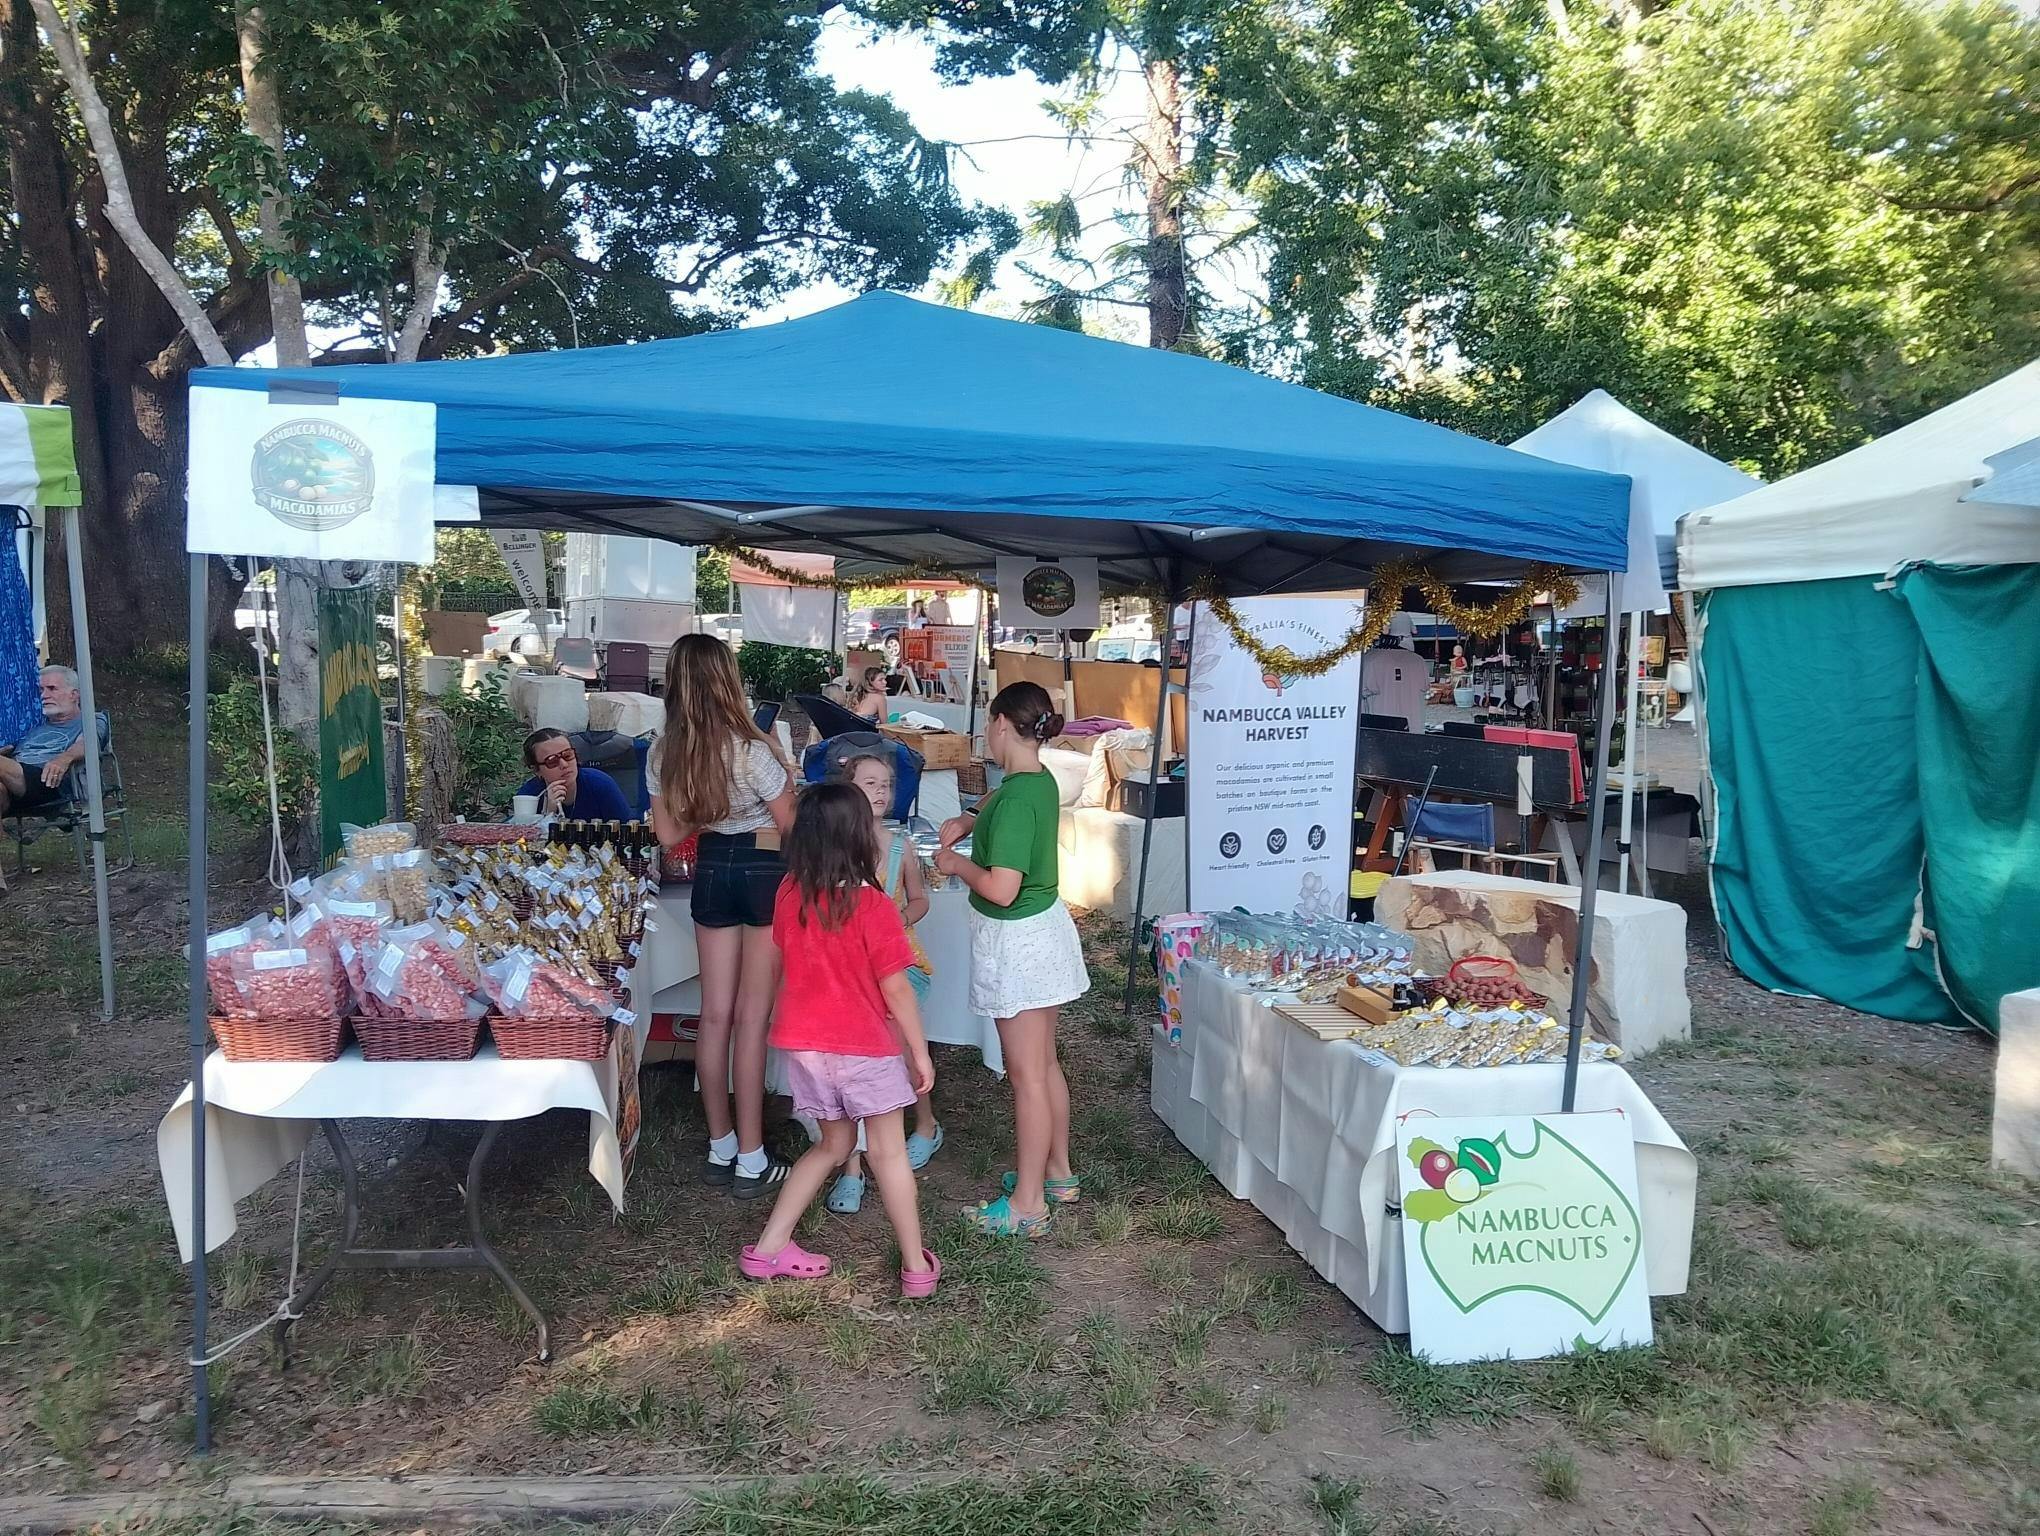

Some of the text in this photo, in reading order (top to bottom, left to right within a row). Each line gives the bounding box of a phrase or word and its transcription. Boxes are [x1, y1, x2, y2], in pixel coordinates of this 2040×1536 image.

[260, 423, 366, 458] NAMBUCCA MACNUTS
[270, 497, 356, 516] MACADAMIAS
[1203, 705, 1347, 723] NAMBUCCA VALLEY
[1246, 726, 1309, 742] HARVEST
[1216, 759, 1335, 771] Our delicious organic and premium
[1216, 776, 1260, 785] macadamias
[1275, 773, 1306, 783] cultivated
[1315, 771, 1334, 780] small
[1216, 791, 1243, 799] batches
[1259, 789, 1287, 798] boutique
[1321, 784, 1333, 793] the
[1227, 804, 1253, 814] pristine
[1254, 802, 1271, 811] NSW
[1271, 799, 1303, 810] mid-north
[1457, 1204, 1617, 1235] NAMBUCCA
[1471, 1235, 1609, 1266] MACNUTS
